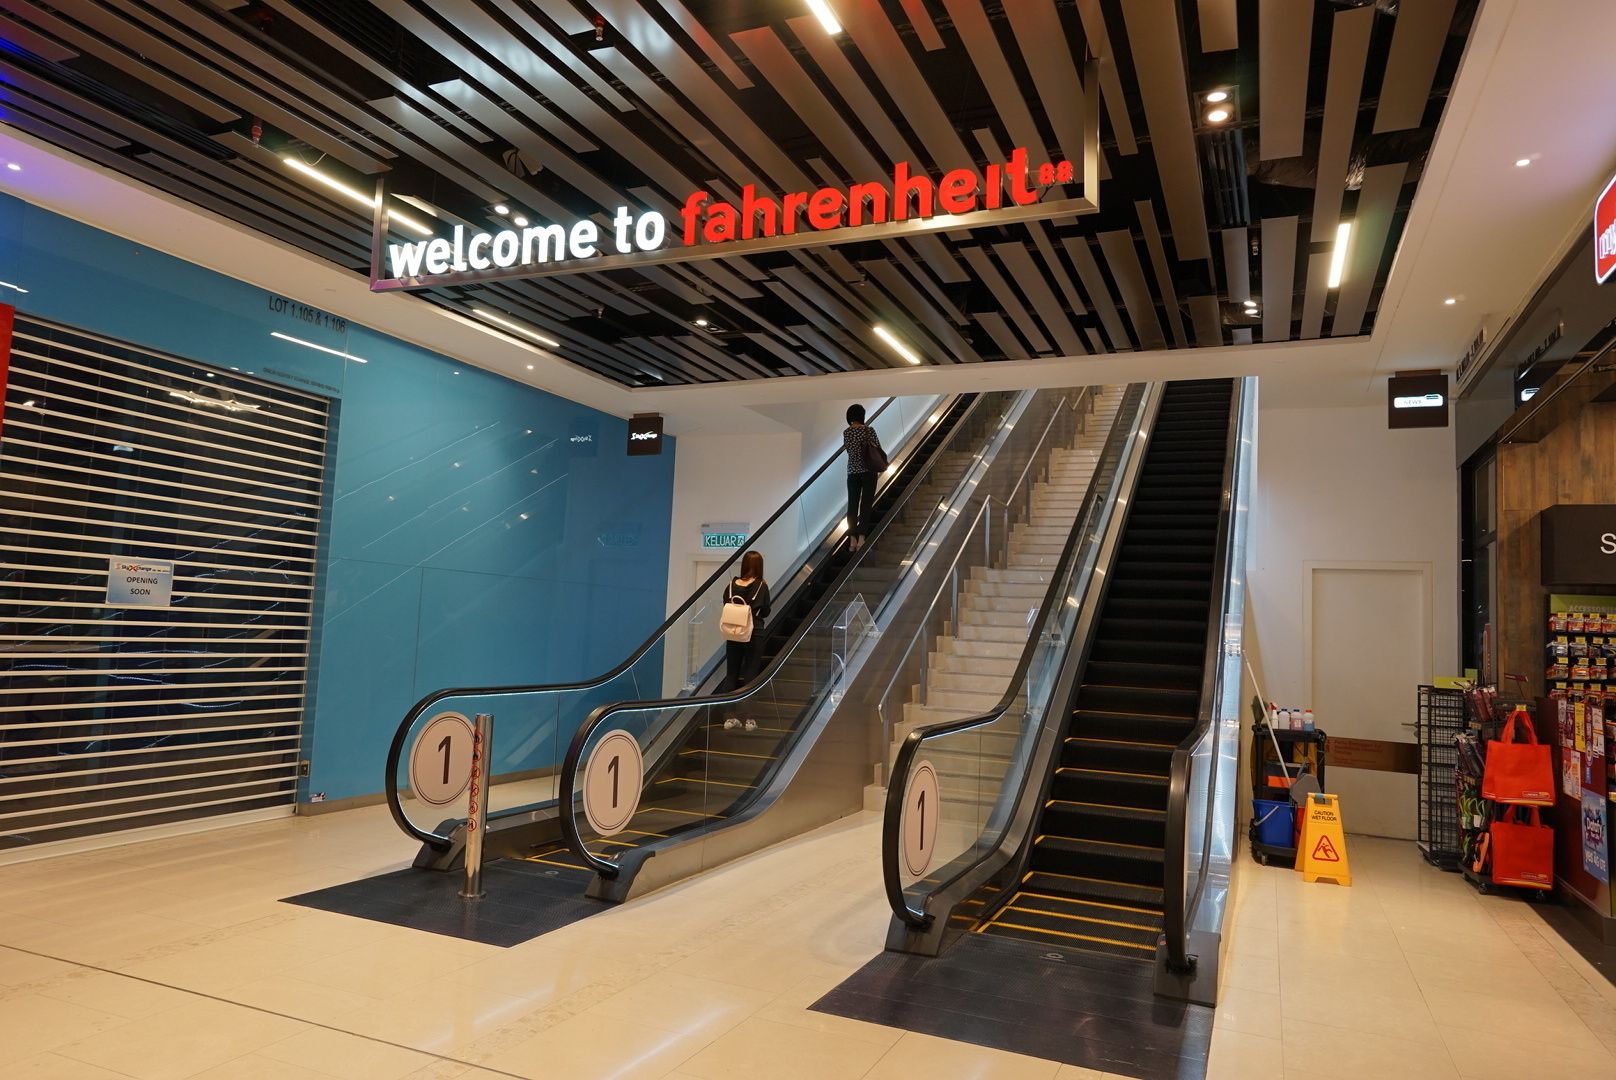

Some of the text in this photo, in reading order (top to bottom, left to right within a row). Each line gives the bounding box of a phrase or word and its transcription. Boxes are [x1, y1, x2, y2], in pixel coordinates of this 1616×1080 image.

[389, 146, 1075, 279] welcome to fahrenheit 88
[269, 295, 346, 334] LOT 1.105 & 1.106
[705, 535, 737, 547] KELUAR
[126, 576, 158, 585] OPENING
[130, 588, 151, 596] SOON
[437, 735, 452, 785] 1
[607, 755, 620, 809] 1
[917, 790, 925, 851] 1
